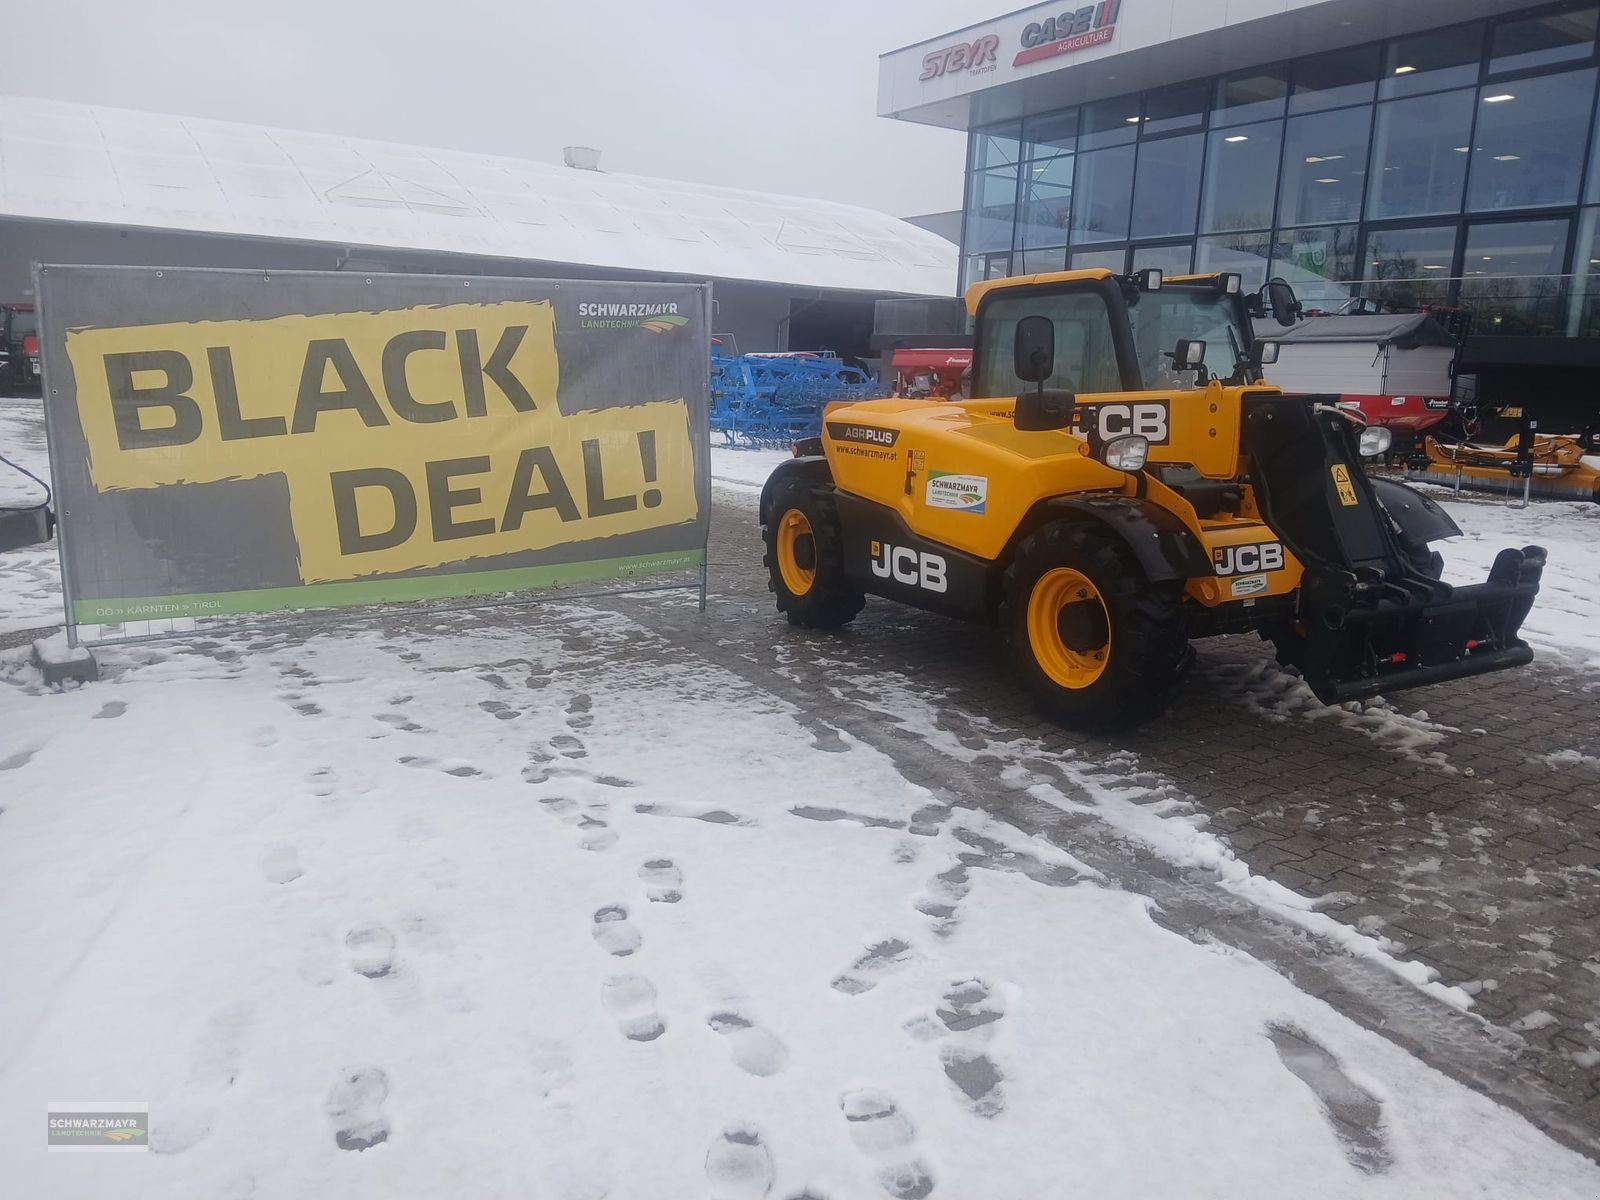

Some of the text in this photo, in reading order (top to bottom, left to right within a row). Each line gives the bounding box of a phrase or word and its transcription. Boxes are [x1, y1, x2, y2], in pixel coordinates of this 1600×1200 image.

[1021, 5, 1094, 48] CASE
[1057, 29, 1109, 52] AGRICULTURE
[919, 34, 999, 80] STEYR
[579, 302, 678, 317] SCHWARZMAYR
[581, 319, 640, 329] LANDTECHNIK
[102, 325, 537, 451] BLACK
[836, 446, 897, 462] www.schwarzmayr.at
[329, 430, 662, 556] DEAL!
[932, 479, 978, 493] SCHWARZMAYR
[618, 556, 691, 571] www.schwarzmayr.at
[871, 543, 948, 593] JCB
[1215, 543, 1283, 575] JCB
[193, 601, 224, 609] TIROL
